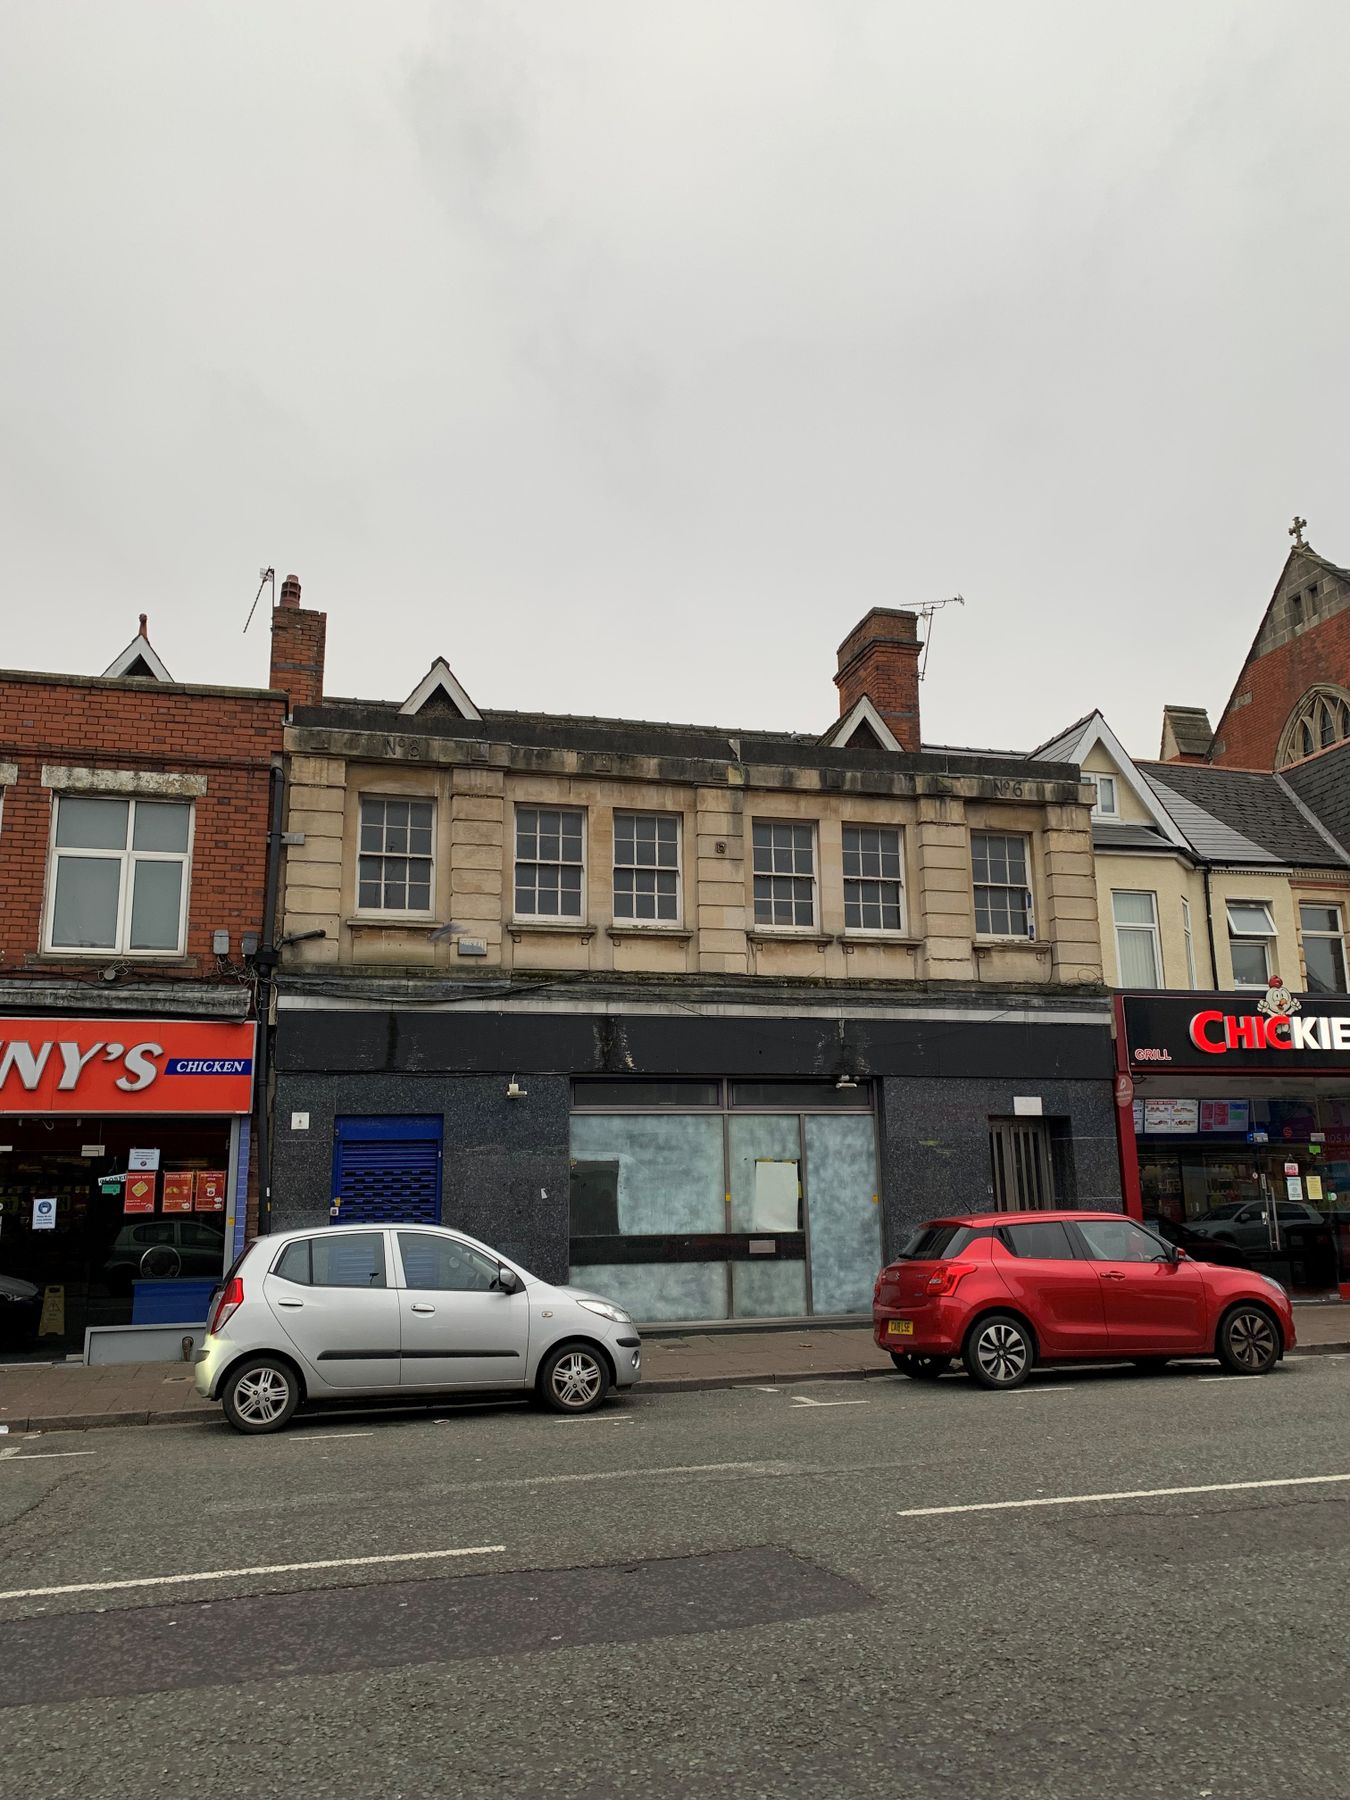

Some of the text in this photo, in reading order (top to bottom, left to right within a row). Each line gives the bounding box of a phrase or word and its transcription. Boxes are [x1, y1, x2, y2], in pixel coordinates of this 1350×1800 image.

[1134, 1048, 1172, 1060] GRILL
[0, 1038, 164, 1091] NY'S
[176, 1060, 245, 1073] CHICKEN
